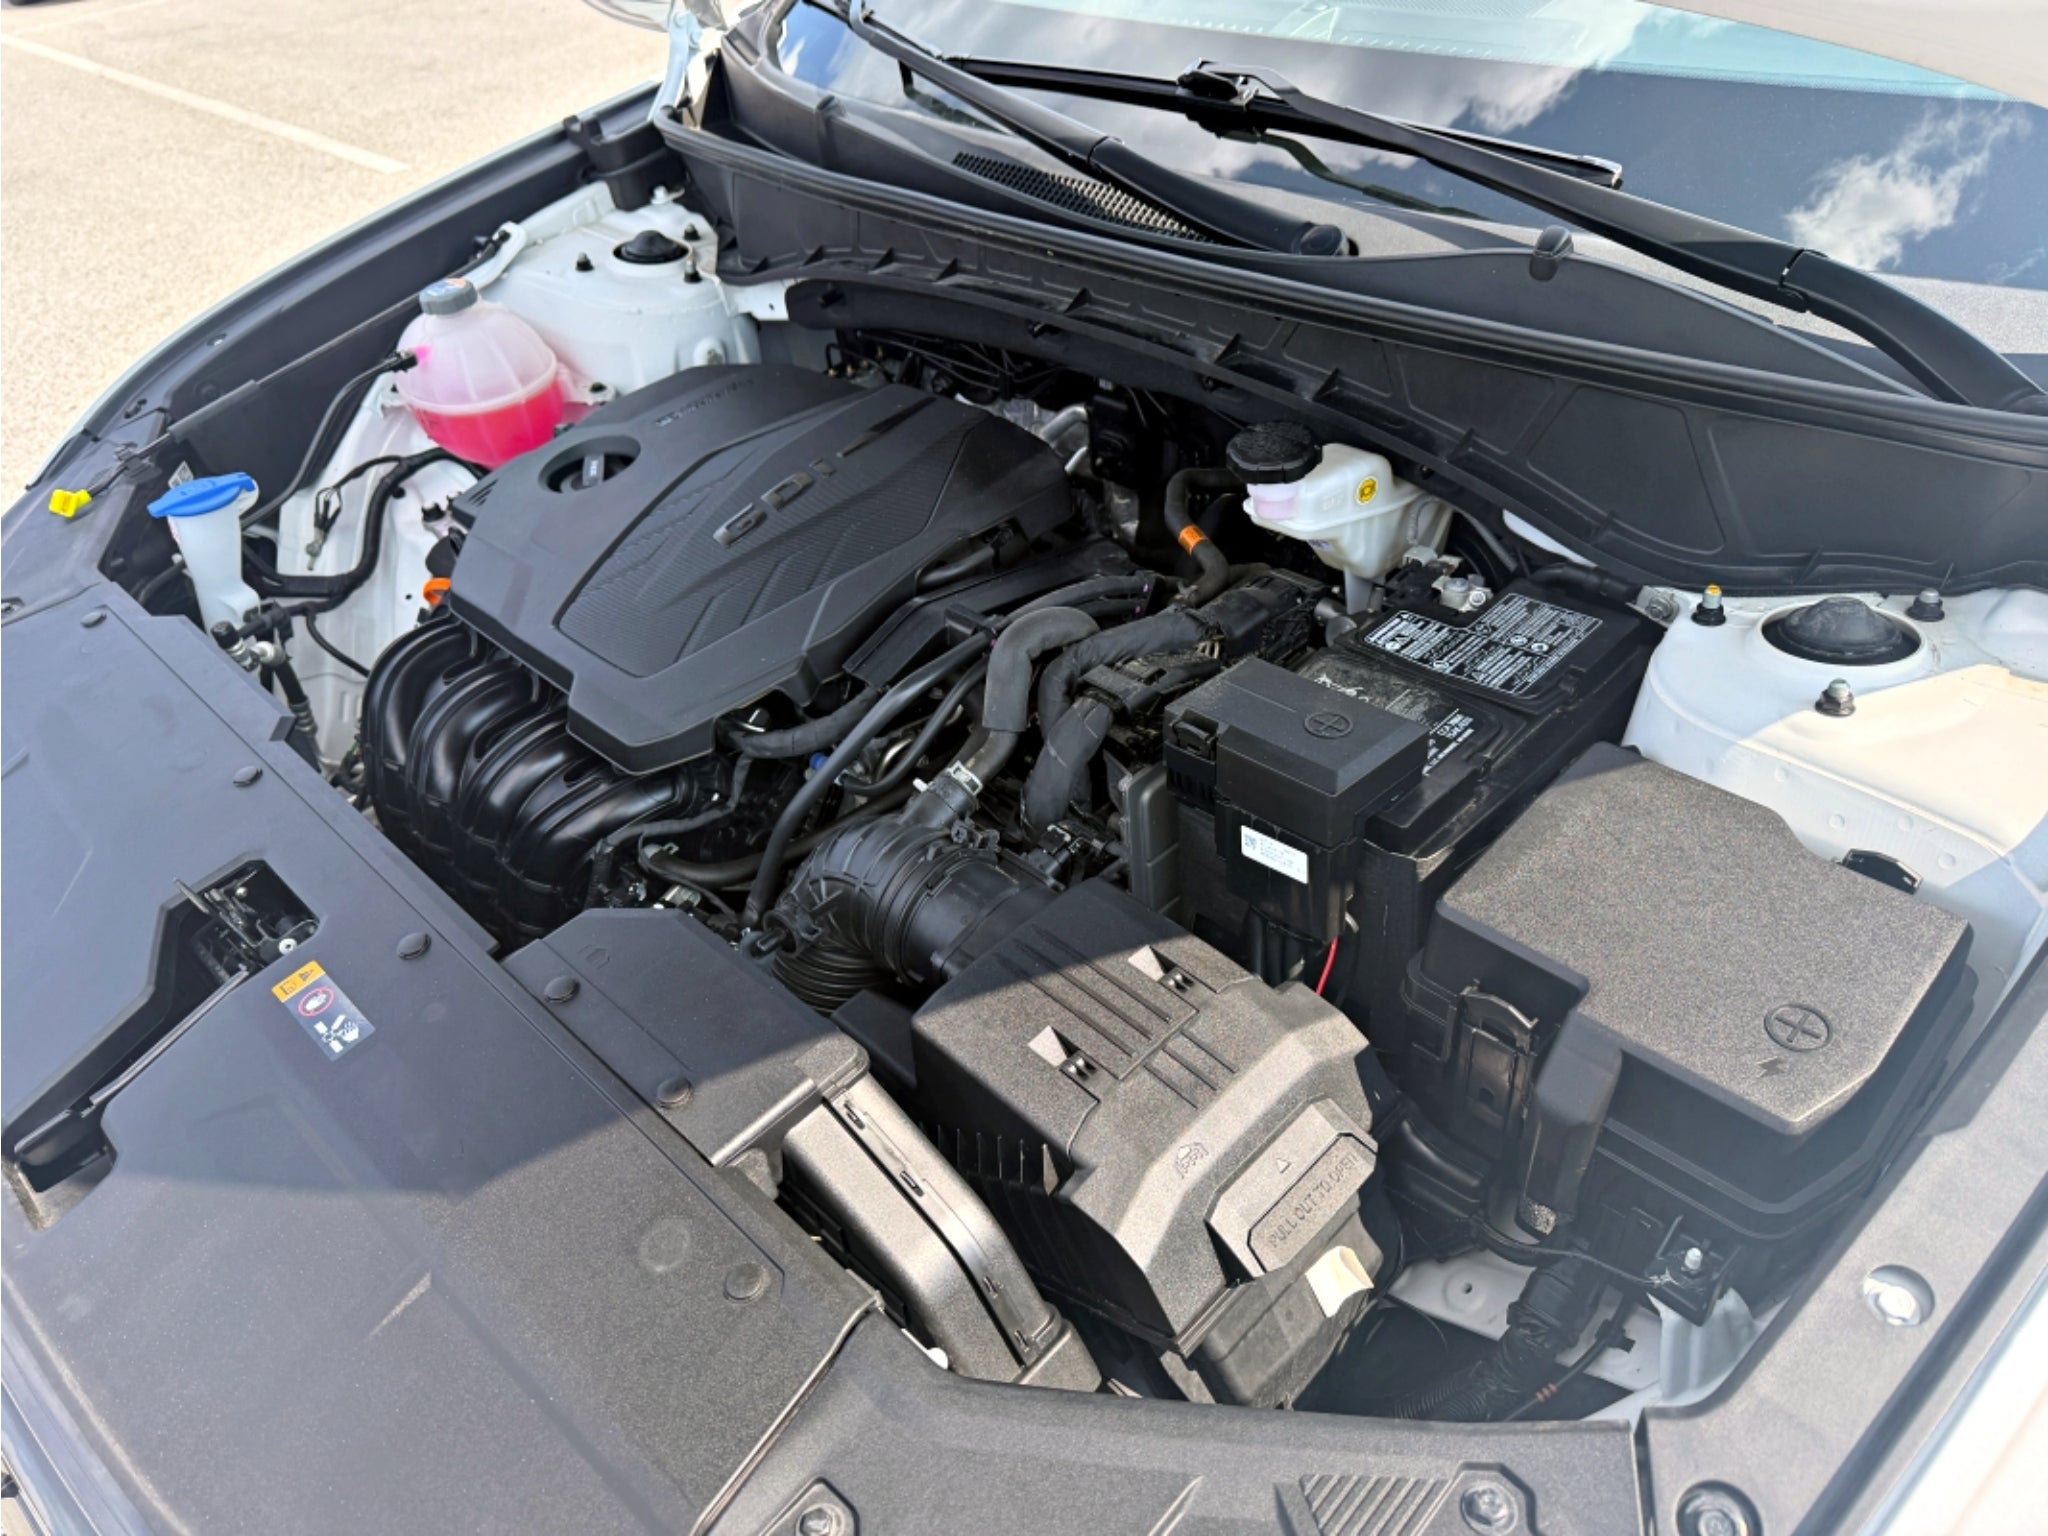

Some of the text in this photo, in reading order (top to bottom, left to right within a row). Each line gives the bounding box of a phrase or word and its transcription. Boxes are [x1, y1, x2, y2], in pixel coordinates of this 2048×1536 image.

[1268, 1151, 1359, 1249] PULL OUT TO OPEN
